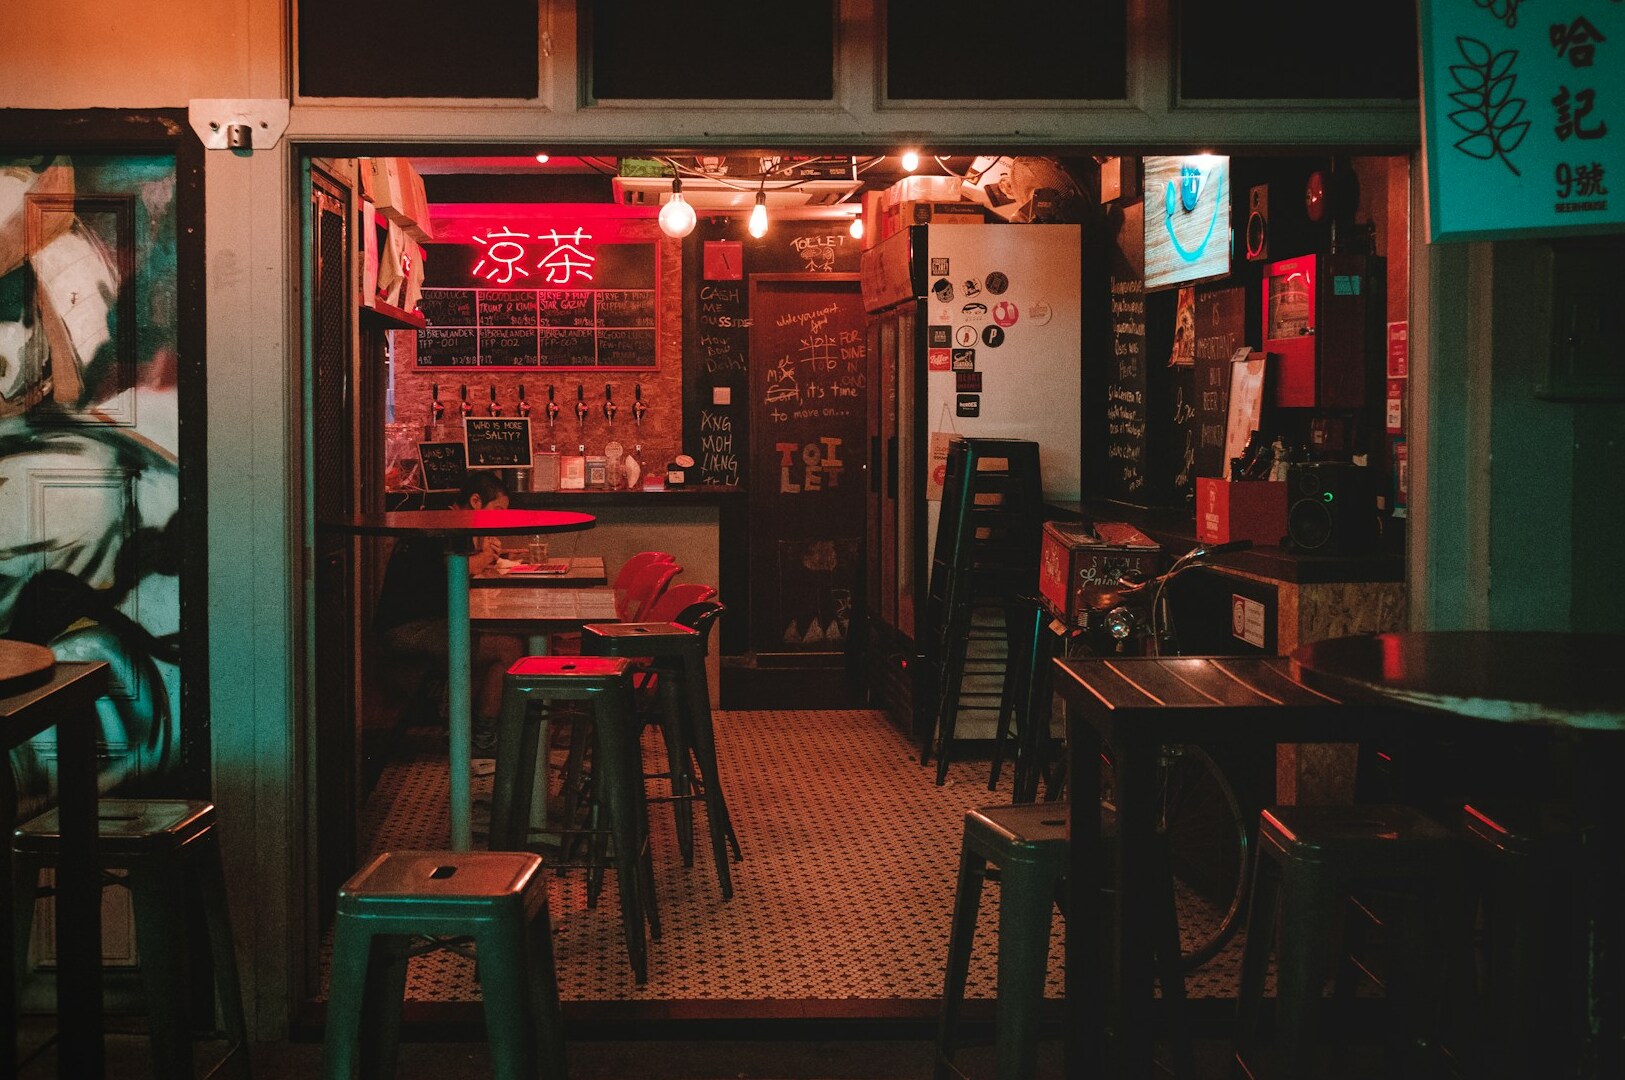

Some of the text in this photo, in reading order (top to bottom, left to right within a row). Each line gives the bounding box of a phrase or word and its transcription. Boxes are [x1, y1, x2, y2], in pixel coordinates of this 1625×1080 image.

[700, 286, 740, 304] CASH
[702, 303, 725, 313] ME
[840, 330, 863, 345] FOR
[840, 345, 866, 360] DINE
[830, 381, 858, 397] time
[770, 408, 788, 423] to
[793, 408, 819, 419] move
[472, 421, 523, 431] WHO IS MORE
[485, 430, 521, 442] SALTY?
[701, 433, 733, 454] MOH
